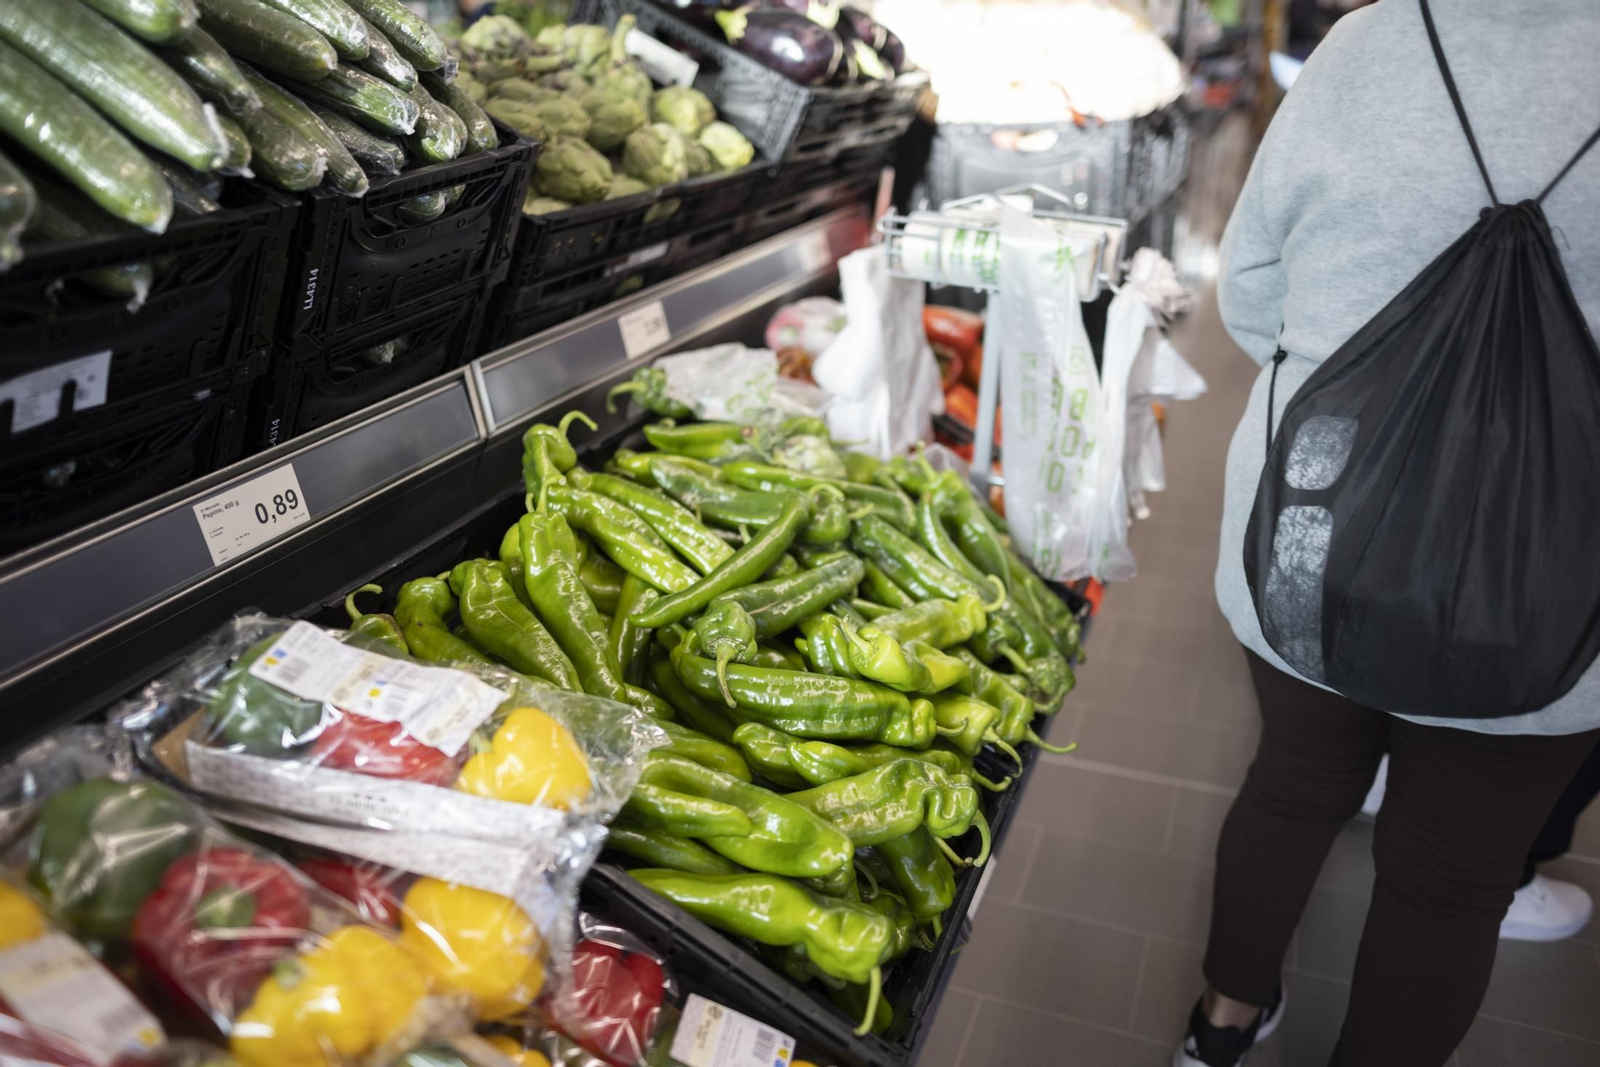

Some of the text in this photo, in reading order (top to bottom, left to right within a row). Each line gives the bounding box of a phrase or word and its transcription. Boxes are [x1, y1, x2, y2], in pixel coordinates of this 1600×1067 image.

[303, 268, 319, 310] LL4314
[224, 501, 234, 510] 400
[254, 488, 299, 524] 0,89
